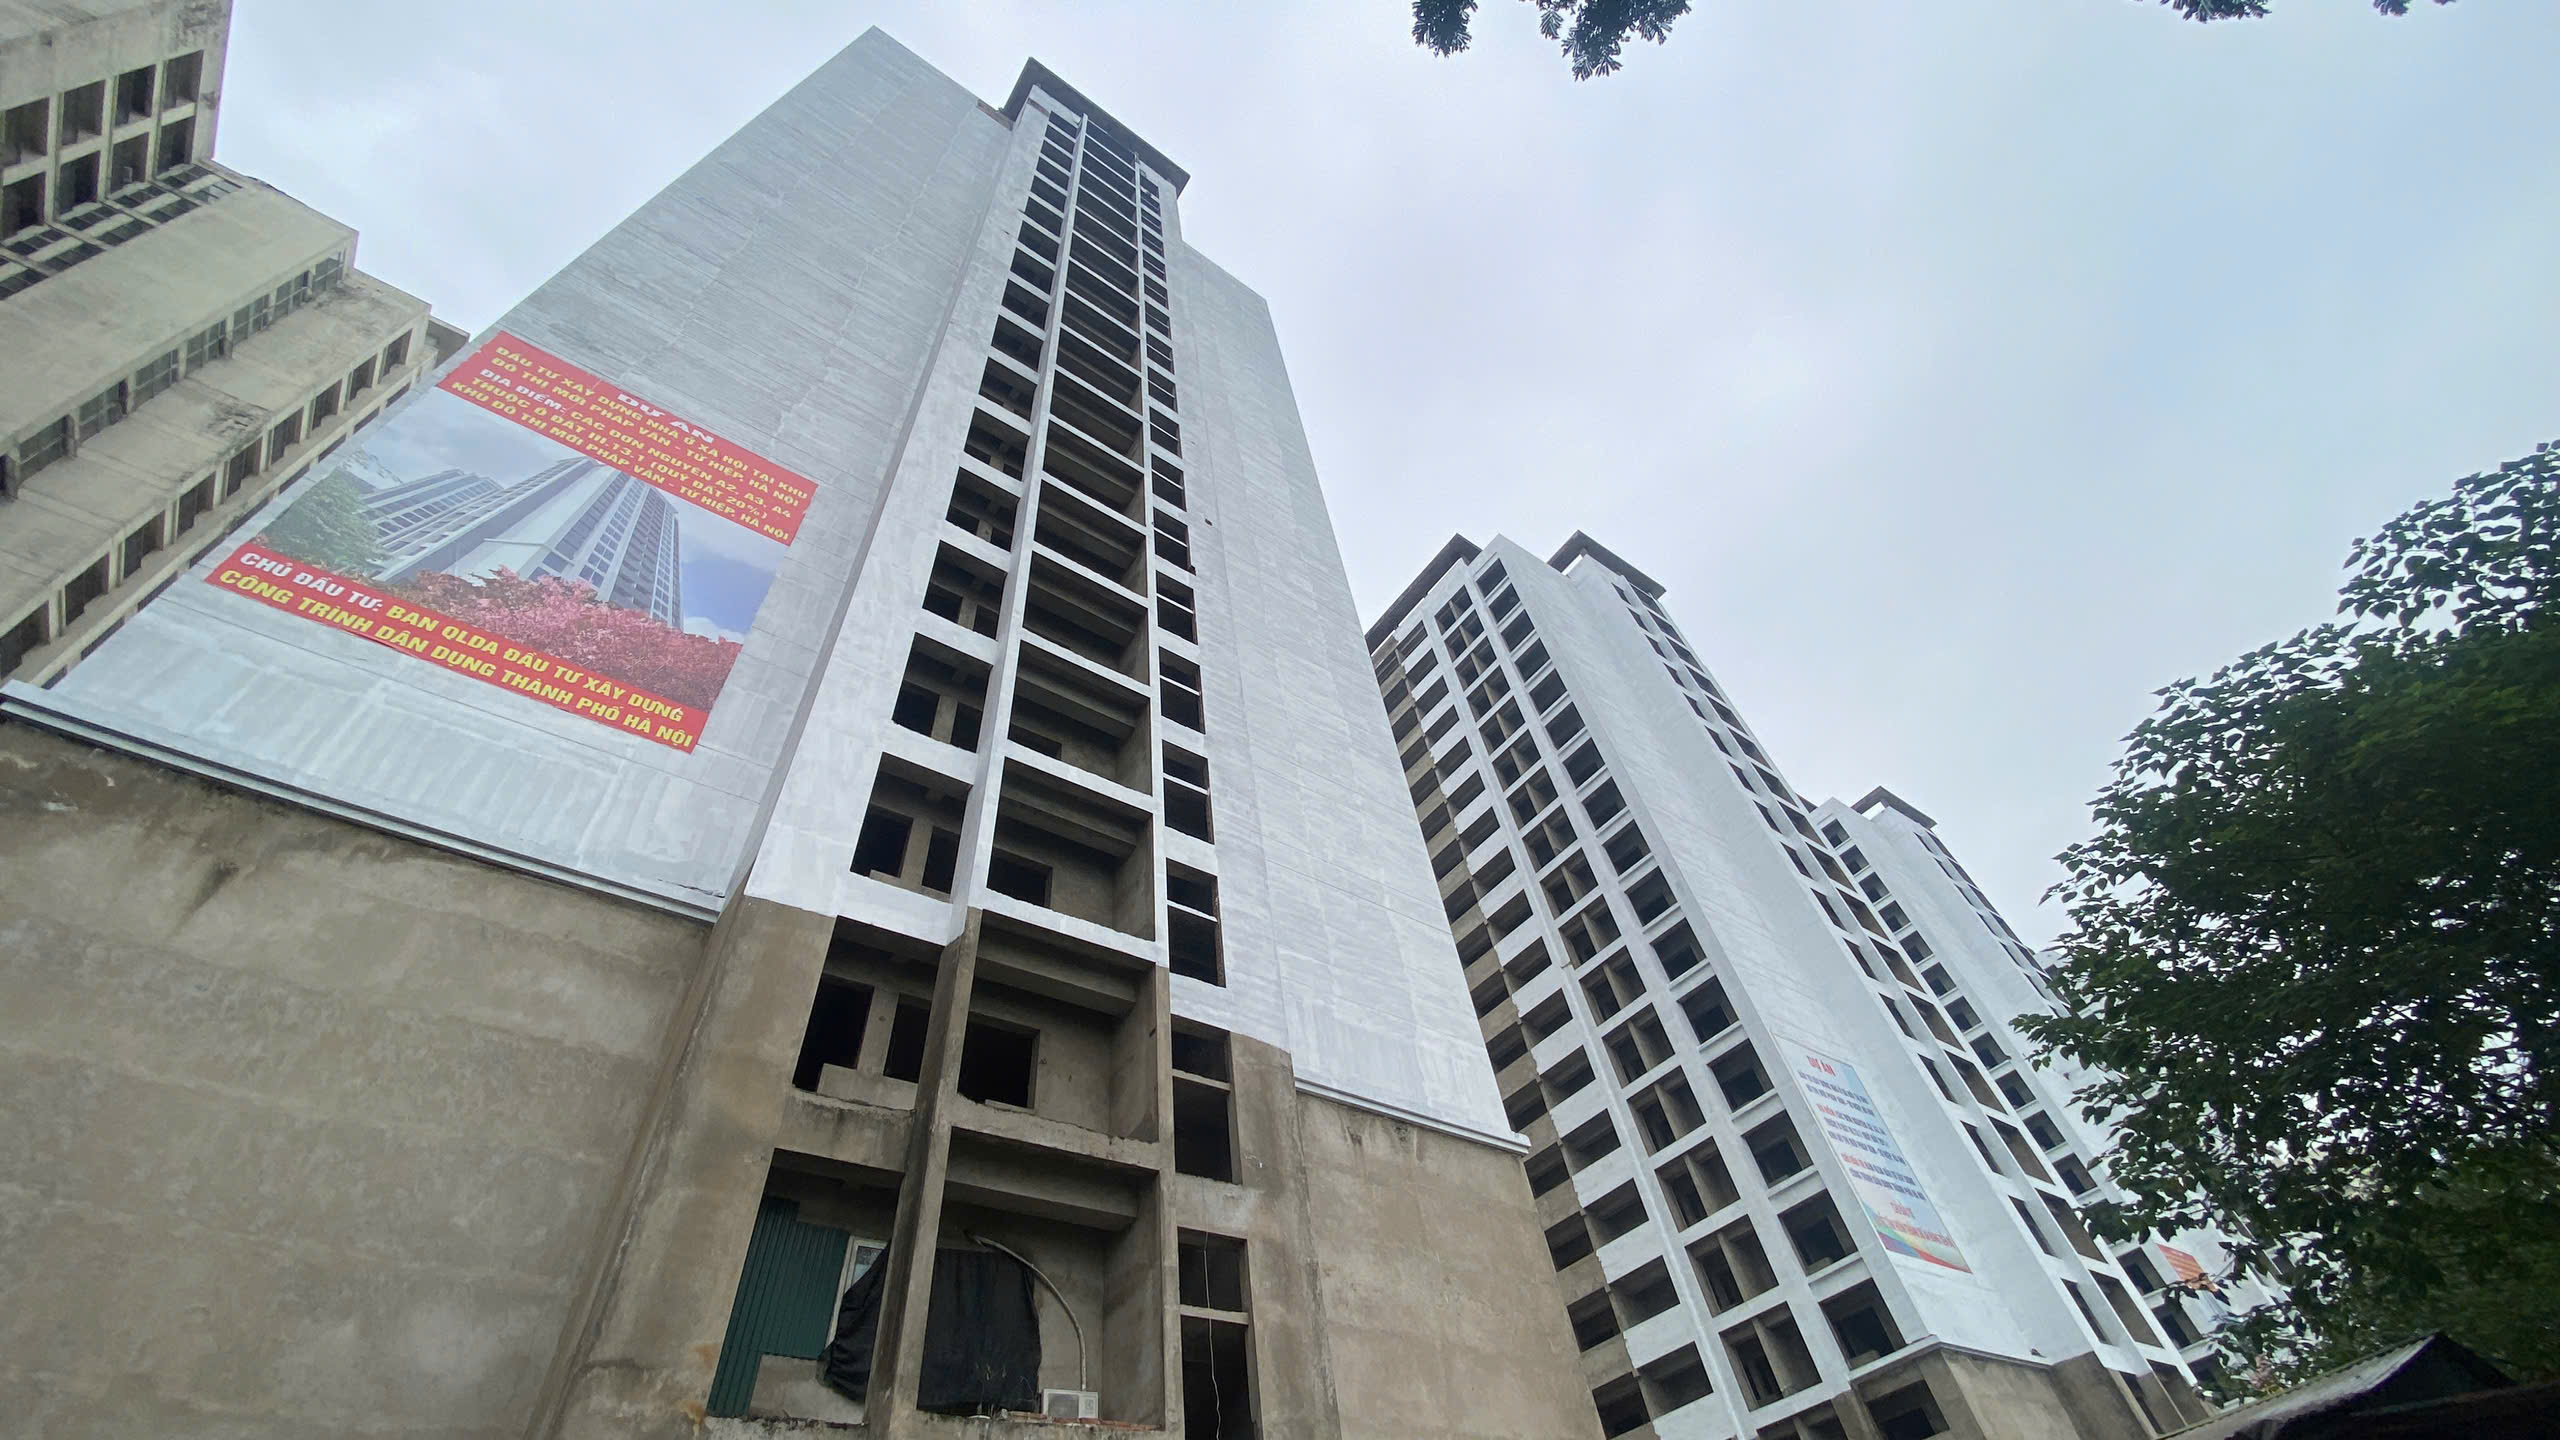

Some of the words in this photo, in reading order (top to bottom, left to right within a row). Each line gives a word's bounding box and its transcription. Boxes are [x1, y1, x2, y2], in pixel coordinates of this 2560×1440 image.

[219, 570, 293, 603] CÔNG
[297, 596, 373, 632] TRÌNH
[374, 625, 429, 652] DÂN
[430, 645, 496, 677] DỤNG
[501, 669, 573, 704] THÀNH
[575, 696, 623, 720] PHỐ
[622, 713, 650, 733] HÀ
[655, 725, 692, 747] NỘI
[240, 552, 292, 576] CHỦ
[292, 571, 344, 596] ĐẦU
[347, 590, 382, 611] TƯ:
[385, 605, 439, 631] BAN
[441, 625, 498, 655] QLDA
[502, 647, 549, 671] ĐẦU
[553, 665, 584, 683] TƯ
[582, 676, 625, 699] XÂY
[627, 693, 683, 721] DỰNG
